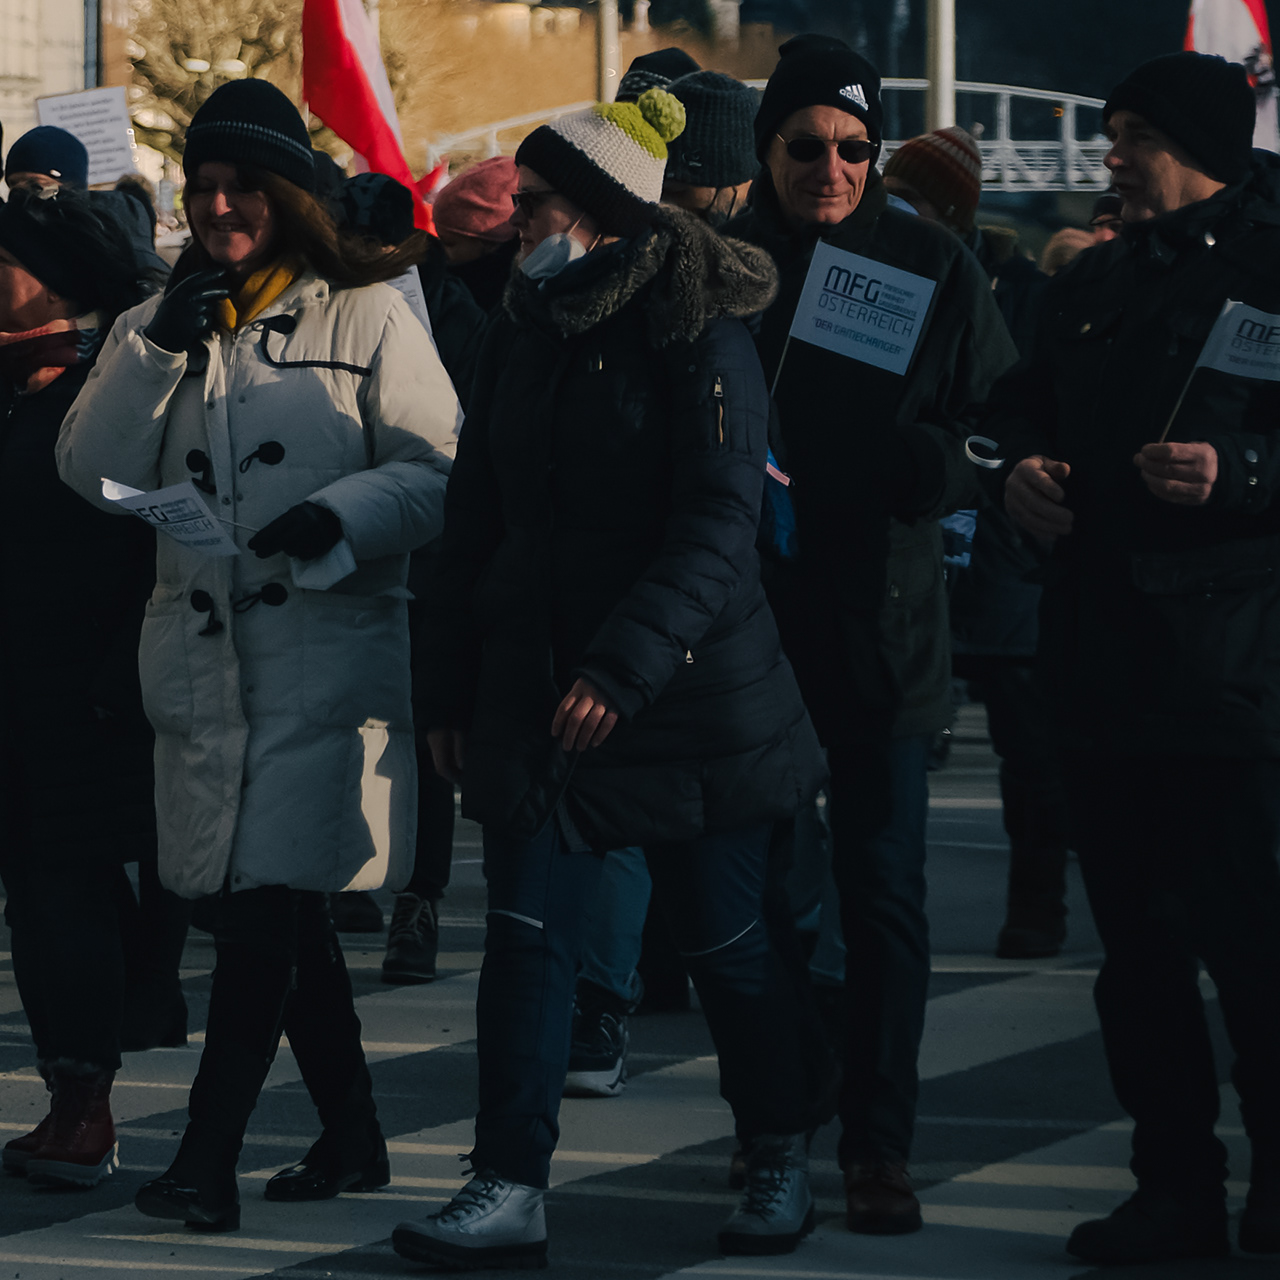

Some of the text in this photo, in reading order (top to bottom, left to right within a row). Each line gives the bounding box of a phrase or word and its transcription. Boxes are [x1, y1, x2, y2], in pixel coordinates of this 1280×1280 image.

[824, 265, 882, 304] MFG
[1237, 319, 1280, 341] MF
[136, 505, 169, 522] FG
[165, 519, 215, 535] RREICH
